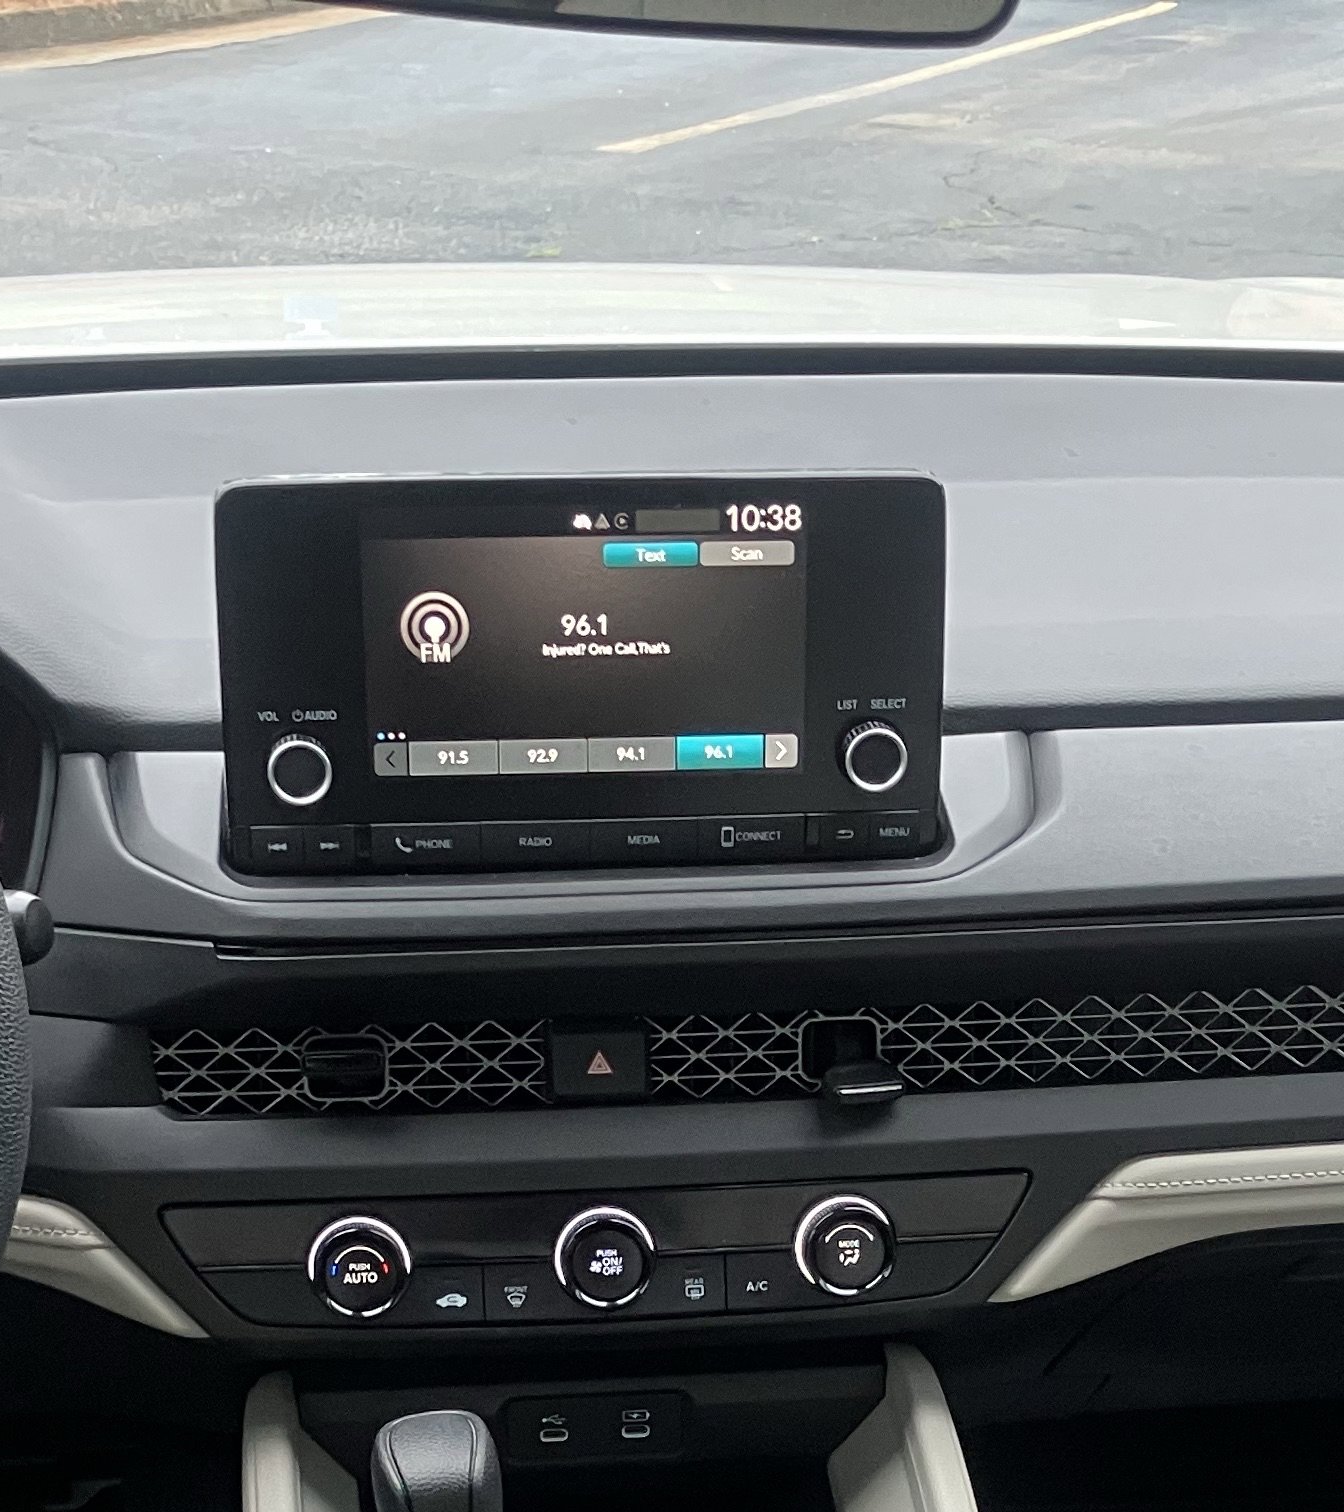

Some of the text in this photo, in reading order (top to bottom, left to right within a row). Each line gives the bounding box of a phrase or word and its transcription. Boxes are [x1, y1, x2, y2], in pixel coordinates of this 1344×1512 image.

[725, 503, 803, 532] 10:38
[636, 548, 666, 562] Text
[731, 546, 763, 561] Scan
[561, 614, 609, 636] 96.1
[421, 644, 452, 664] FM
[588, 642, 613, 656] One
[836, 698, 907, 711] LIST SELECT
[257, 709, 338, 722] VOL AUDIO
[437, 745, 734, 766] 91.5 92.9 94.1 96.1
[879, 827, 910, 838] MENU
[416, 830, 782, 850] PHONE RADIO MEDIA CONNECT
[343, 1271, 378, 1284] AUTO
[602, 1265, 624, 1276] OFF
[746, 1281, 768, 1292] A/C
